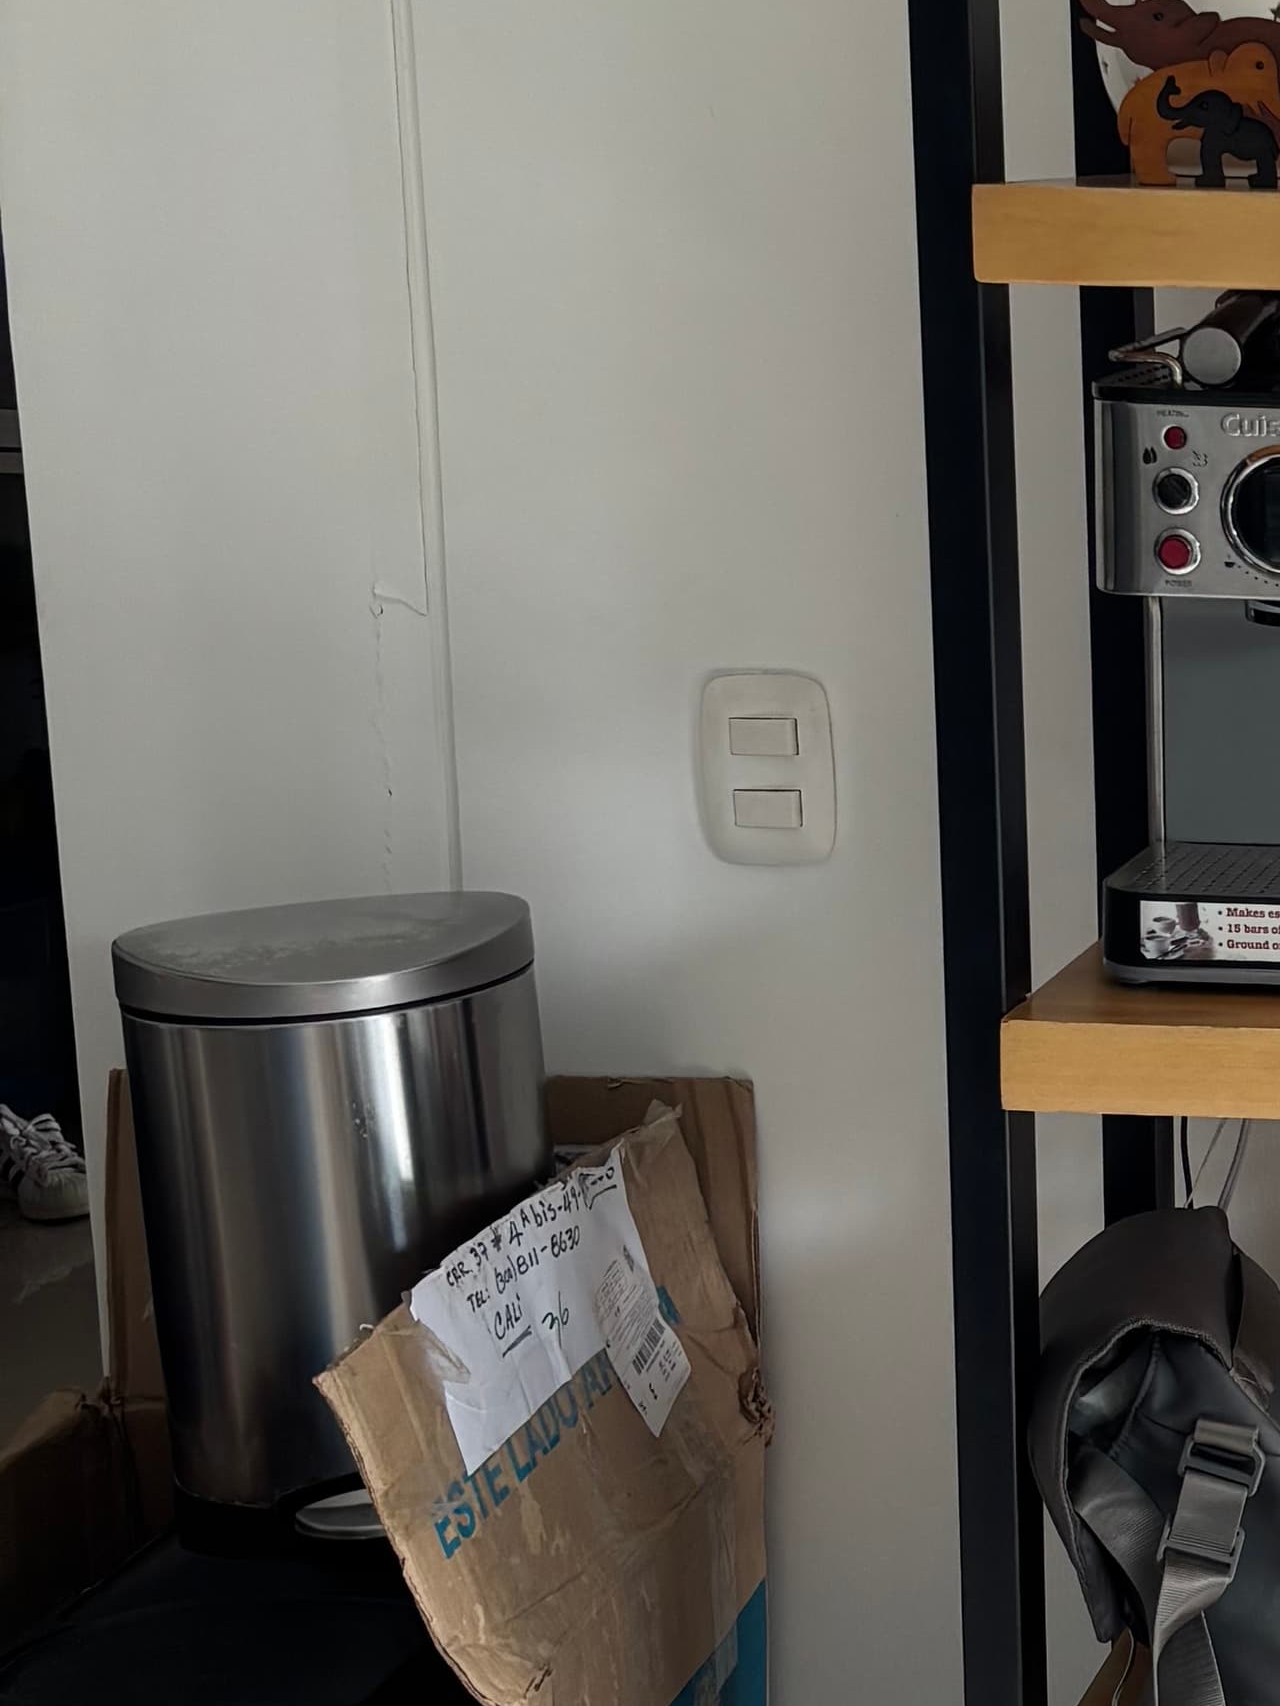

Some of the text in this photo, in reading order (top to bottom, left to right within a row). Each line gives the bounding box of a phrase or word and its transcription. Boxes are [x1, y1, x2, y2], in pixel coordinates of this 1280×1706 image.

[1226, 907, 1266, 919] Makes
[1227, 924, 1241, 934] 15
[1244, 924, 1269, 935] bars
[1226, 940, 1270, 951] Ground
[433, 1459, 511, 1559] ESTE
